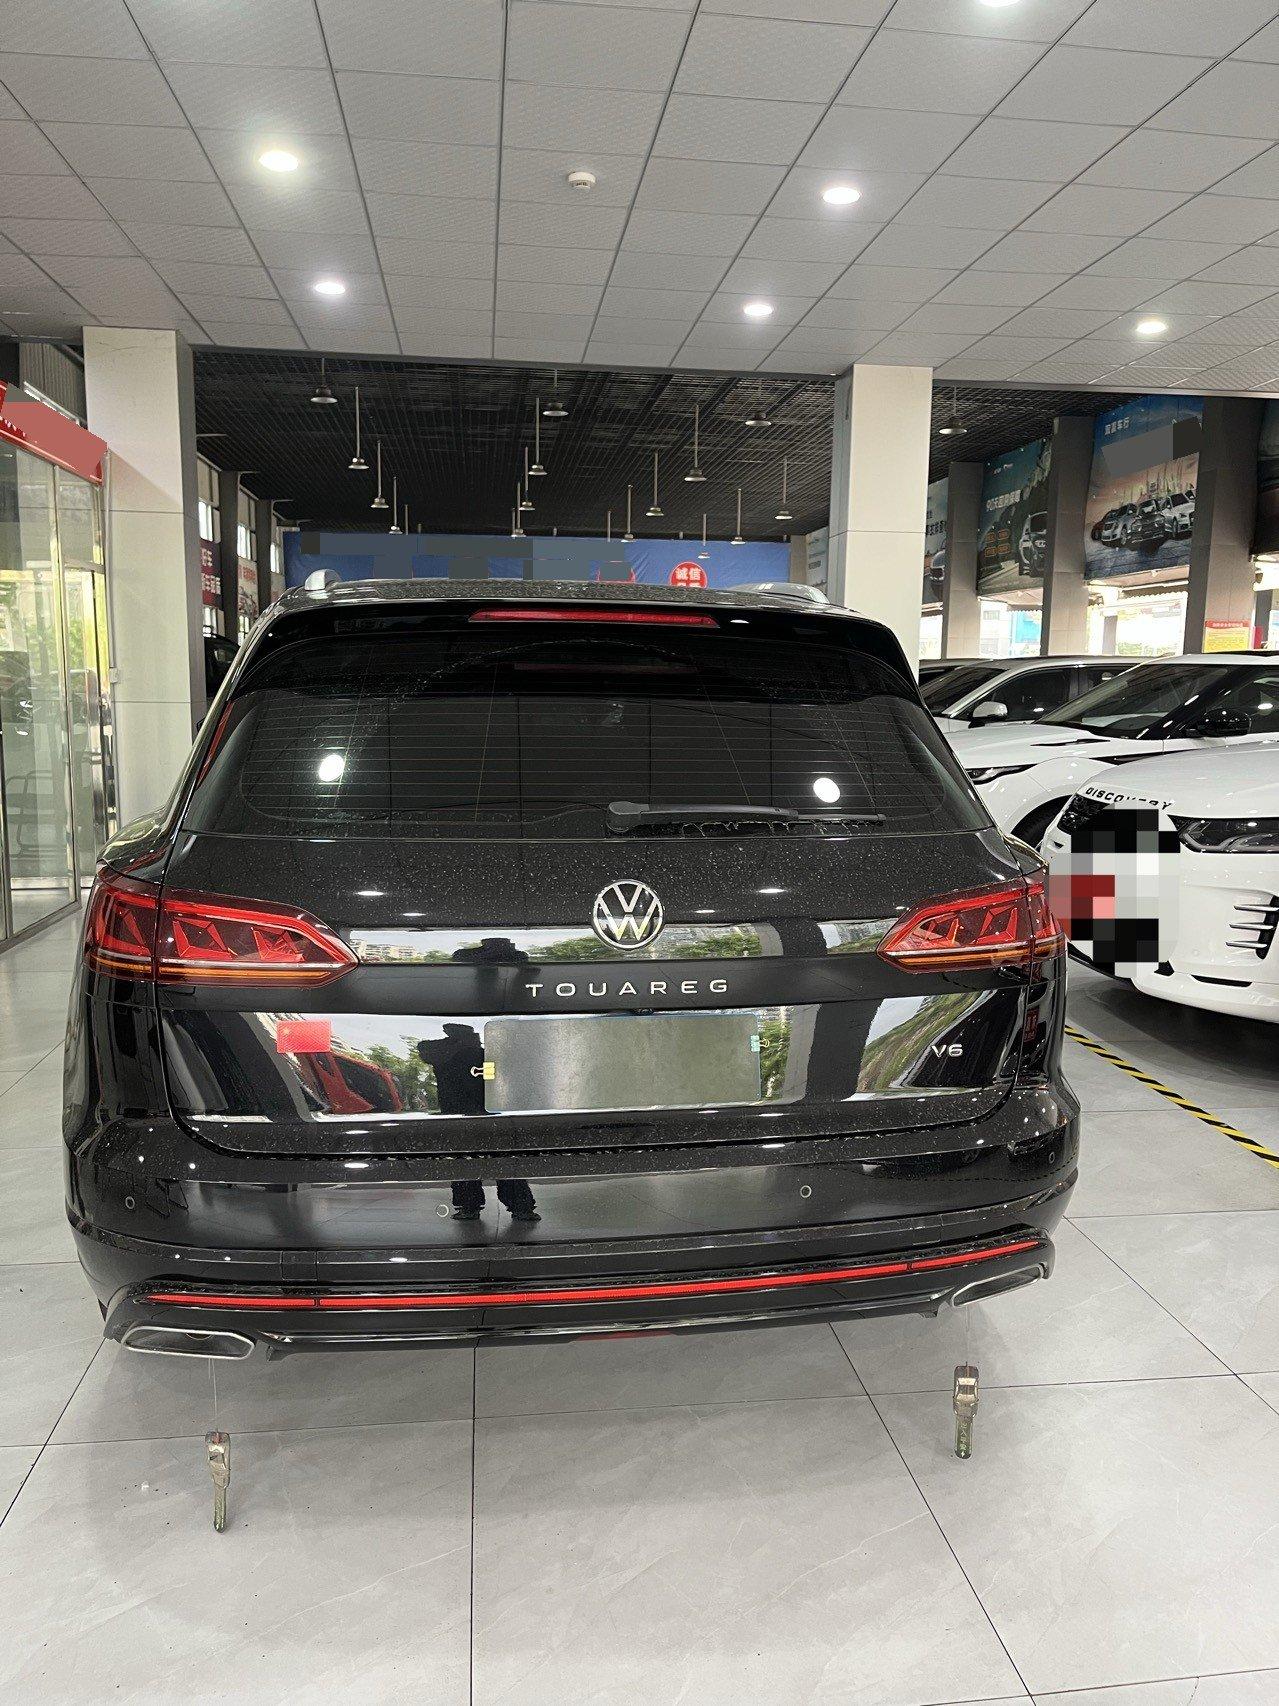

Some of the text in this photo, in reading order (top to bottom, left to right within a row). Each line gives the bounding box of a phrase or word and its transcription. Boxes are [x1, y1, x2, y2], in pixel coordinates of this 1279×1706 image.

[675, 567, 702, 581] 诚信
[1085, 787, 1172, 810] DISCOY
[525, 978, 729, 998] TOUAREG
[932, 1043, 964, 1059] V6
